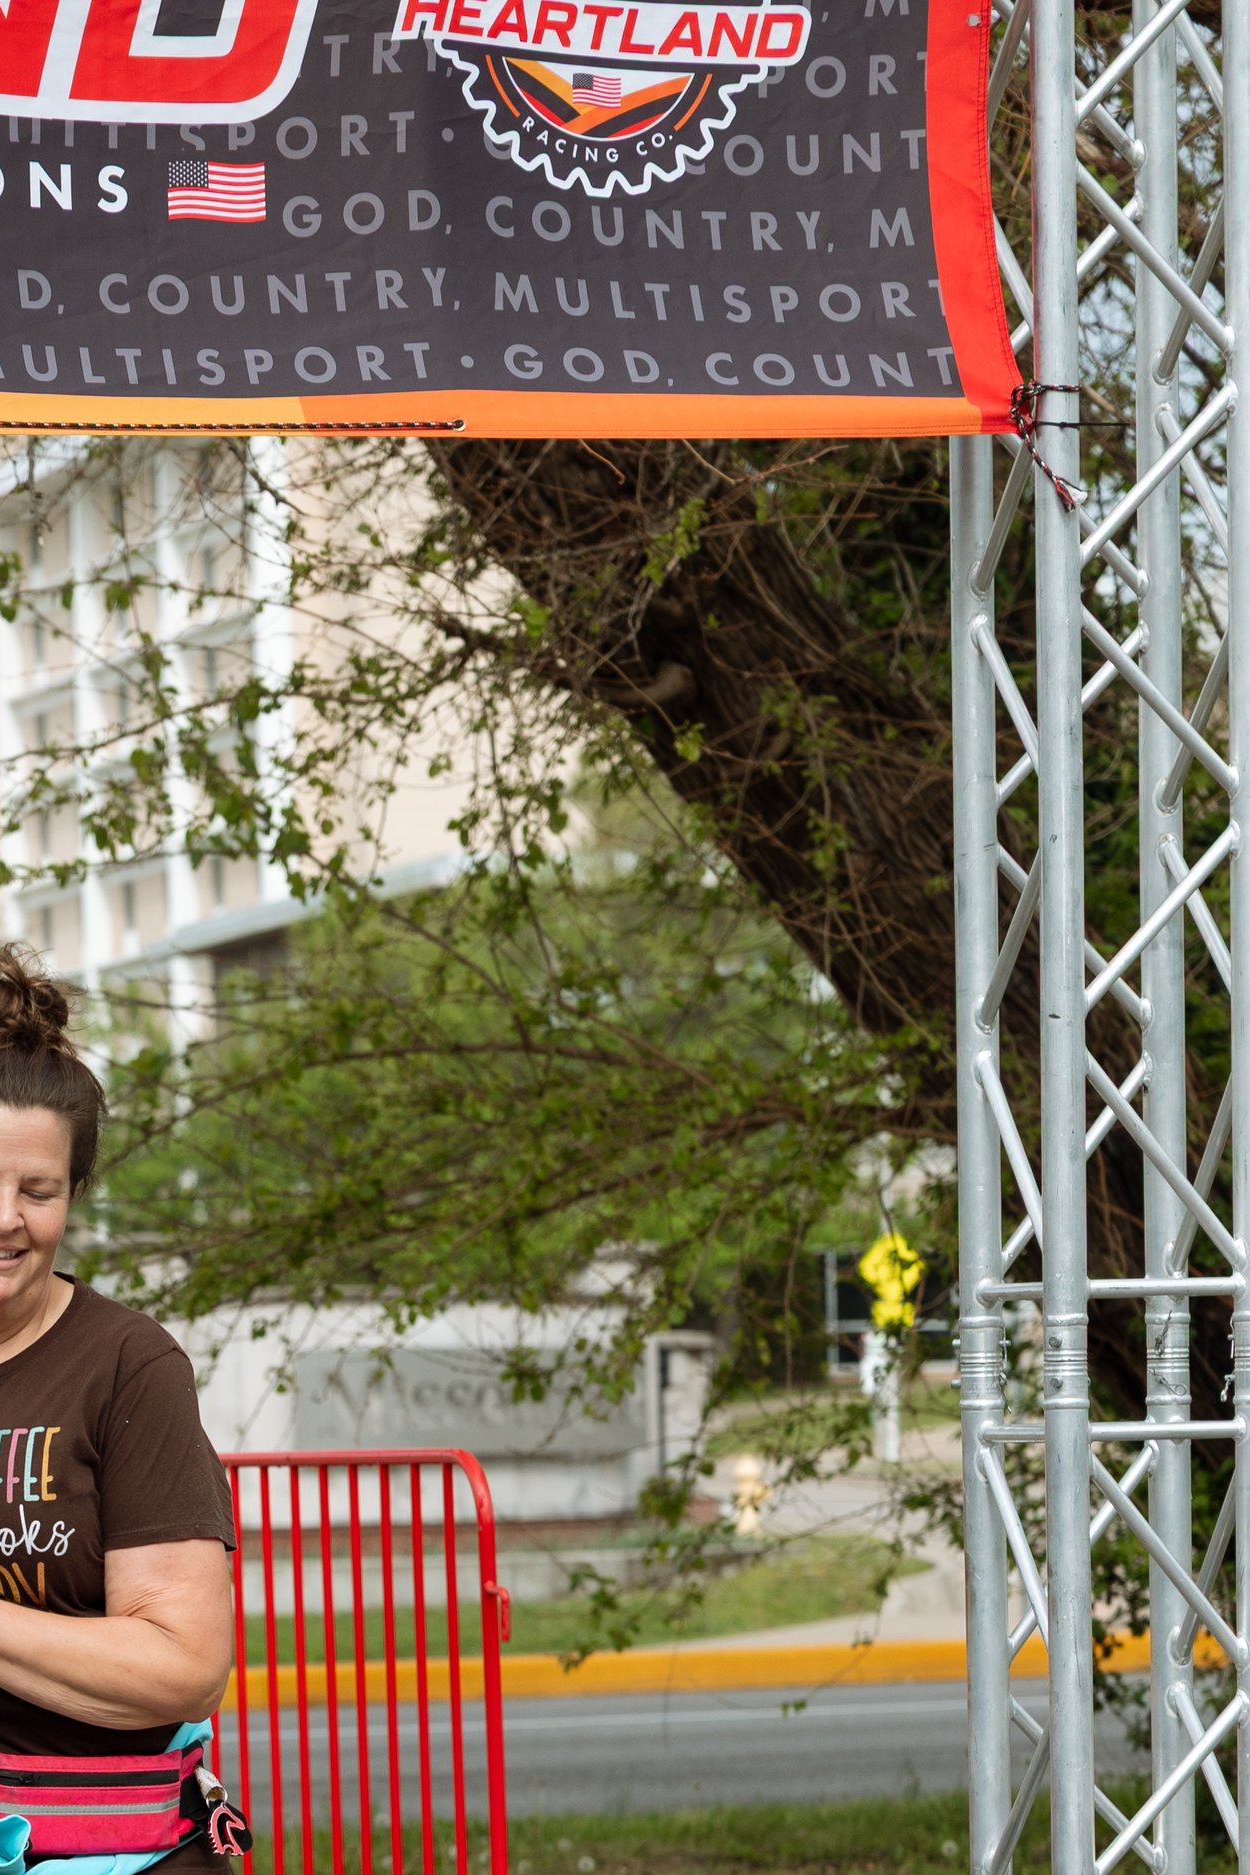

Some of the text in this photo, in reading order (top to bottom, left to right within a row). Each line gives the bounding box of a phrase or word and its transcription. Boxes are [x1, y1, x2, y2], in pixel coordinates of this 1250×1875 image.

[402, 0, 803, 58] HEARTLAND
[522, 115, 620, 163] RACING
[636, 132, 673, 158] CO.
[282, 189, 452, 238] GOD,
[485, 195, 835, 253] COUNTRY,
[98, 266, 461, 317] COUNTRY,
[502, 341, 675, 388] GOD,
